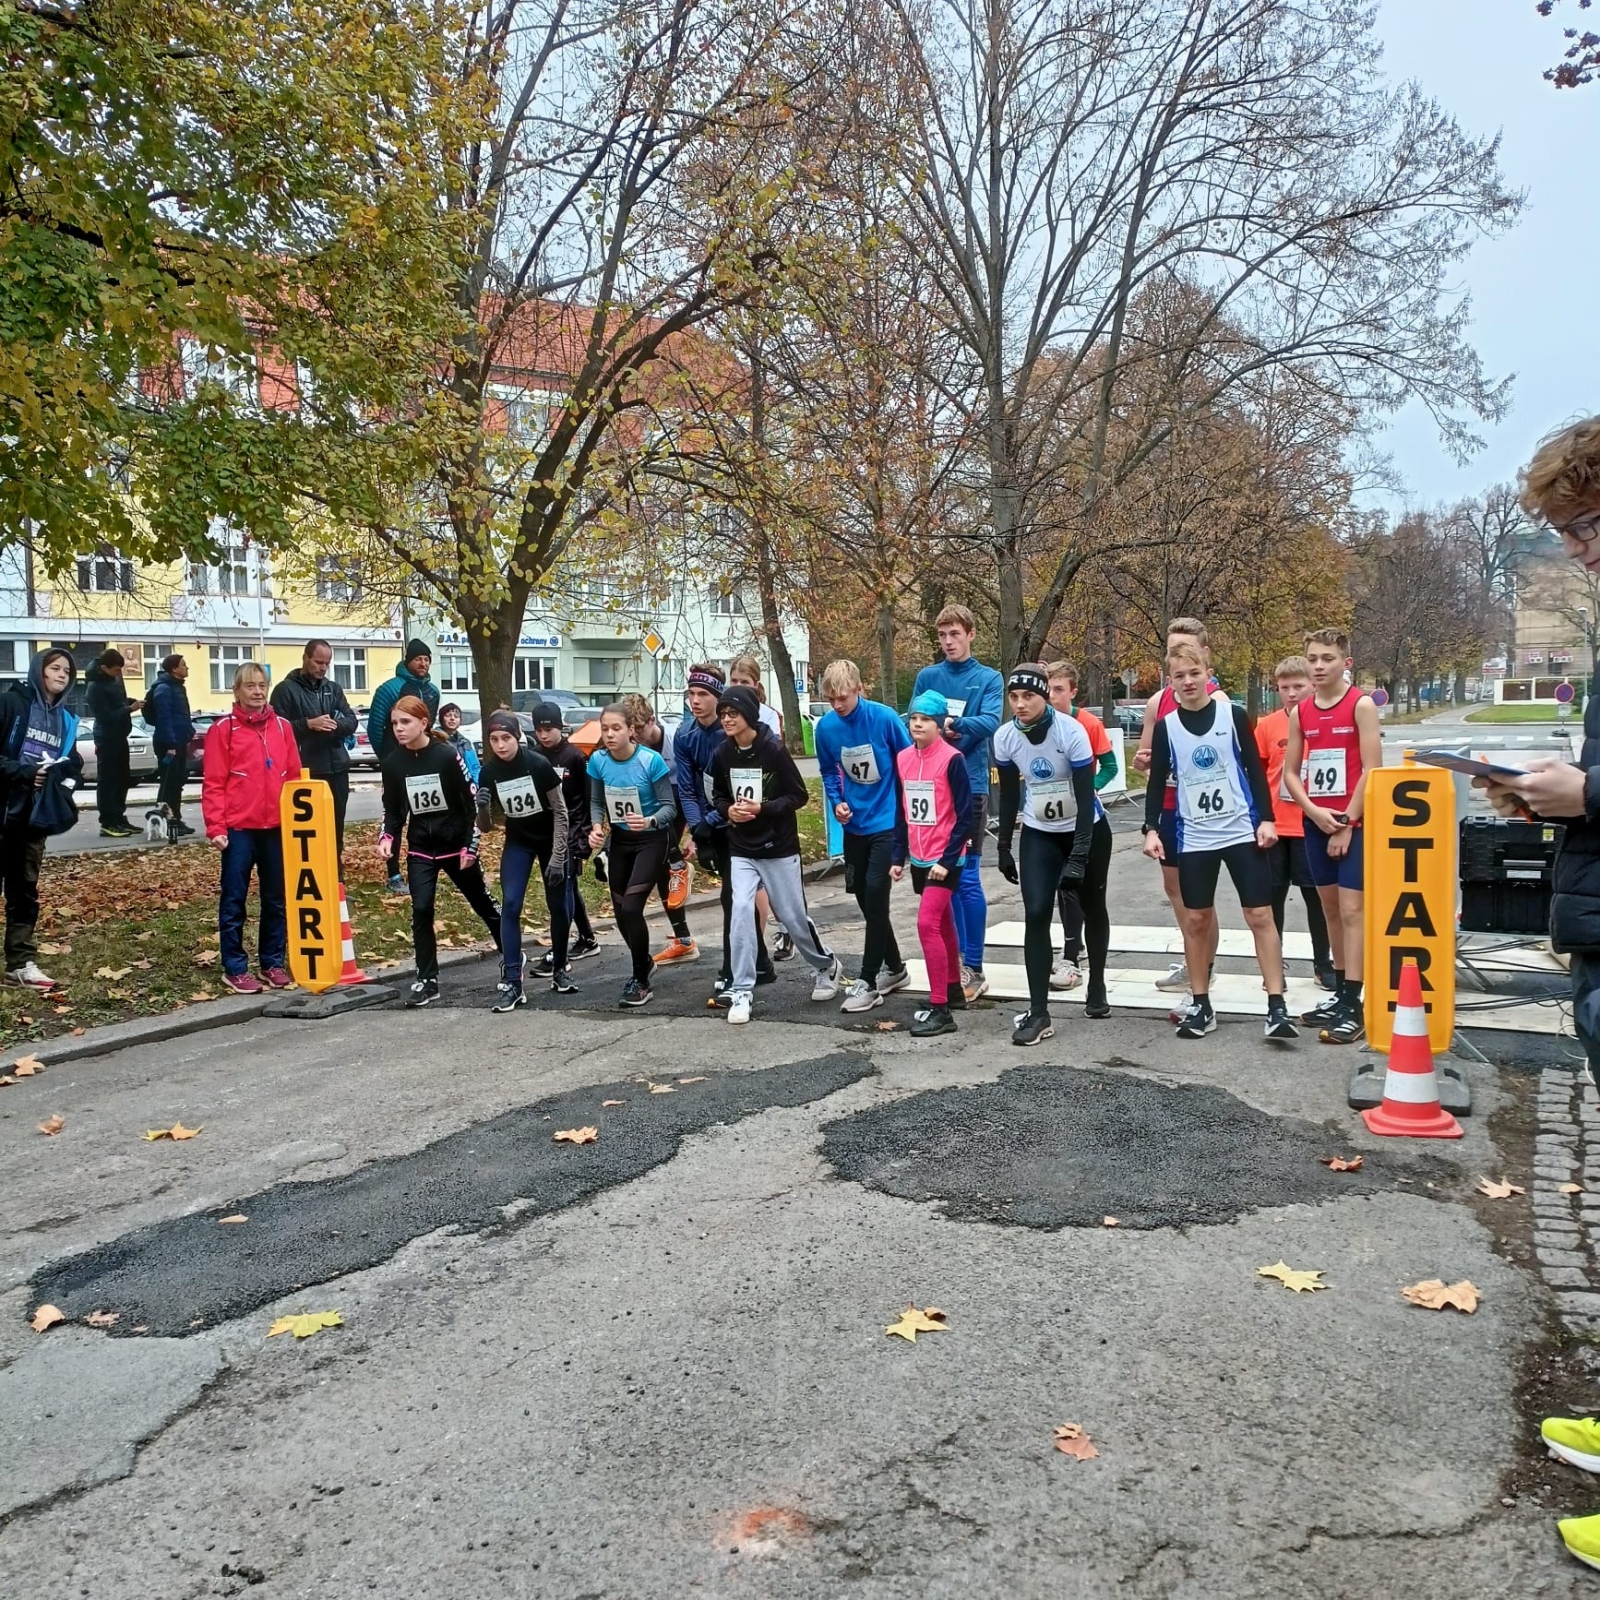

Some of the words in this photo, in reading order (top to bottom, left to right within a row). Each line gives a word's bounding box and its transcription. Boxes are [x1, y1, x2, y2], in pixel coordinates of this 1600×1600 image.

[521, 636, 547, 646] ochrany
[1008, 674, 1050, 693] RTIN
[851, 761, 870, 780] 47
[1314, 767, 1338, 791] 49
[413, 790, 441, 810] 136
[506, 793, 535, 814] 134
[615, 801, 635, 818] 50
[911, 798, 929, 820] 59
[1044, 800, 1063, 819] 61
[1197, 788, 1225, 814] 46
[292, 788, 325, 980] START
